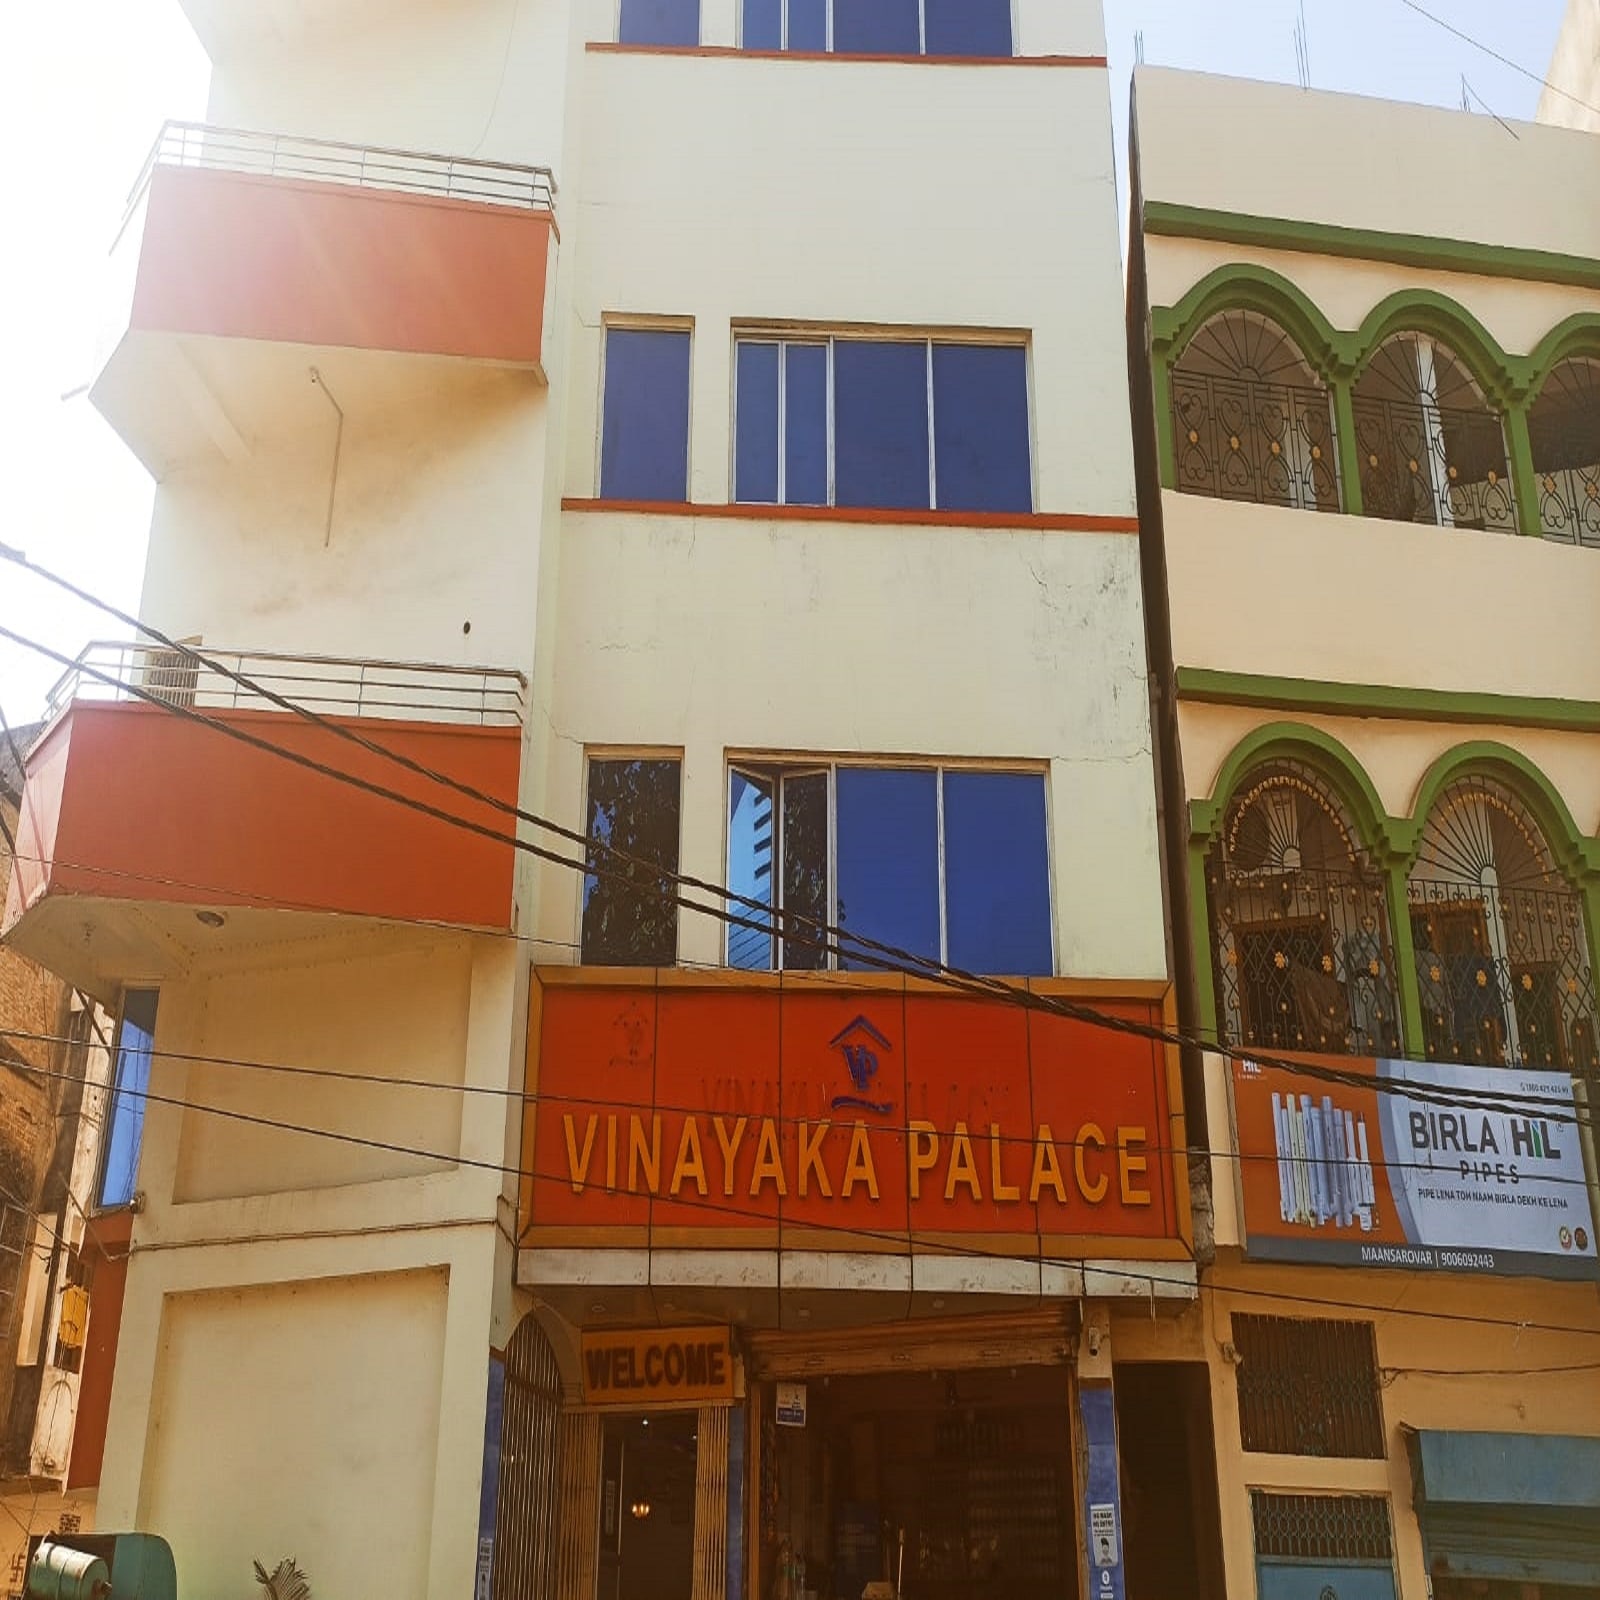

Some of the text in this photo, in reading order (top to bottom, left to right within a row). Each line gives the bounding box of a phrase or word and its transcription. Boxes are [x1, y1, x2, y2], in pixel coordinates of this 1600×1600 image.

[1409, 1111, 1499, 1154] BIRLA
[563, 1114, 1150, 1205] VINAYAKA PALACE
[1459, 1160, 1520, 1184] PIPES
[1418, 1188, 1435, 1199] PIPE
[1436, 1189, 1455, 1200] LENA
[1495, 1193, 1516, 1204] BIRLA
[1538, 1197, 1549, 1207] KE
[1549, 1197, 1568, 1209] LENA
[1361, 1245, 1433, 1265] MAANSAROVAR
[1441, 1252, 1495, 1268] 9006092443
[585, 1342, 726, 1390] WELCOME
